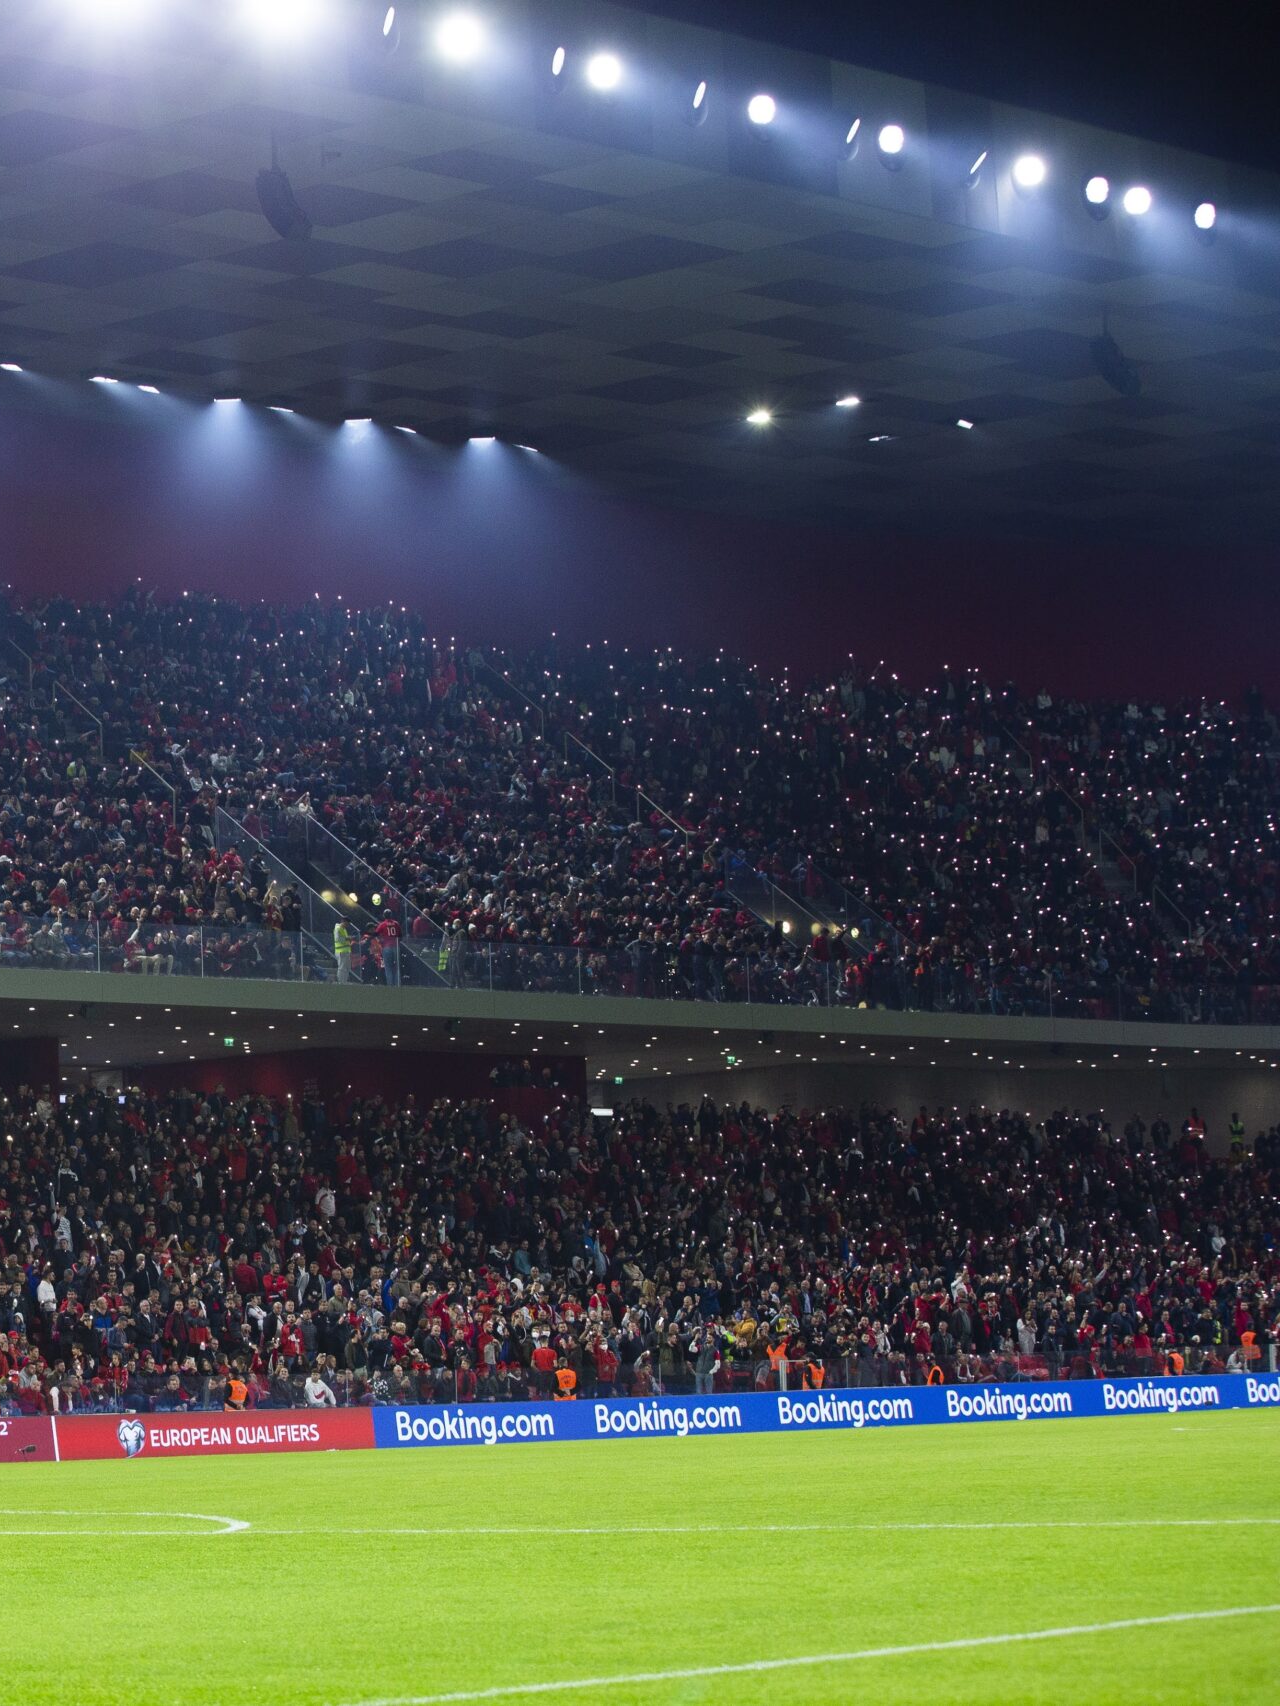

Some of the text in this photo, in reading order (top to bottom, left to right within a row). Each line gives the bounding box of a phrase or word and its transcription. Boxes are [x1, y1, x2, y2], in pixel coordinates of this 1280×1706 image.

[947, 1387, 1072, 1420] Booking.com
[1103, 1381, 1220, 1413] Booking.com
[1245, 1376, 1280, 1403] Boo
[396, 1408, 555, 1445] Booking.com
[595, 1401, 742, 1437] Booking.com
[778, 1393, 914, 1428] Booking.com
[150, 1423, 320, 1447] EUROPEAN QUALIFIERS
